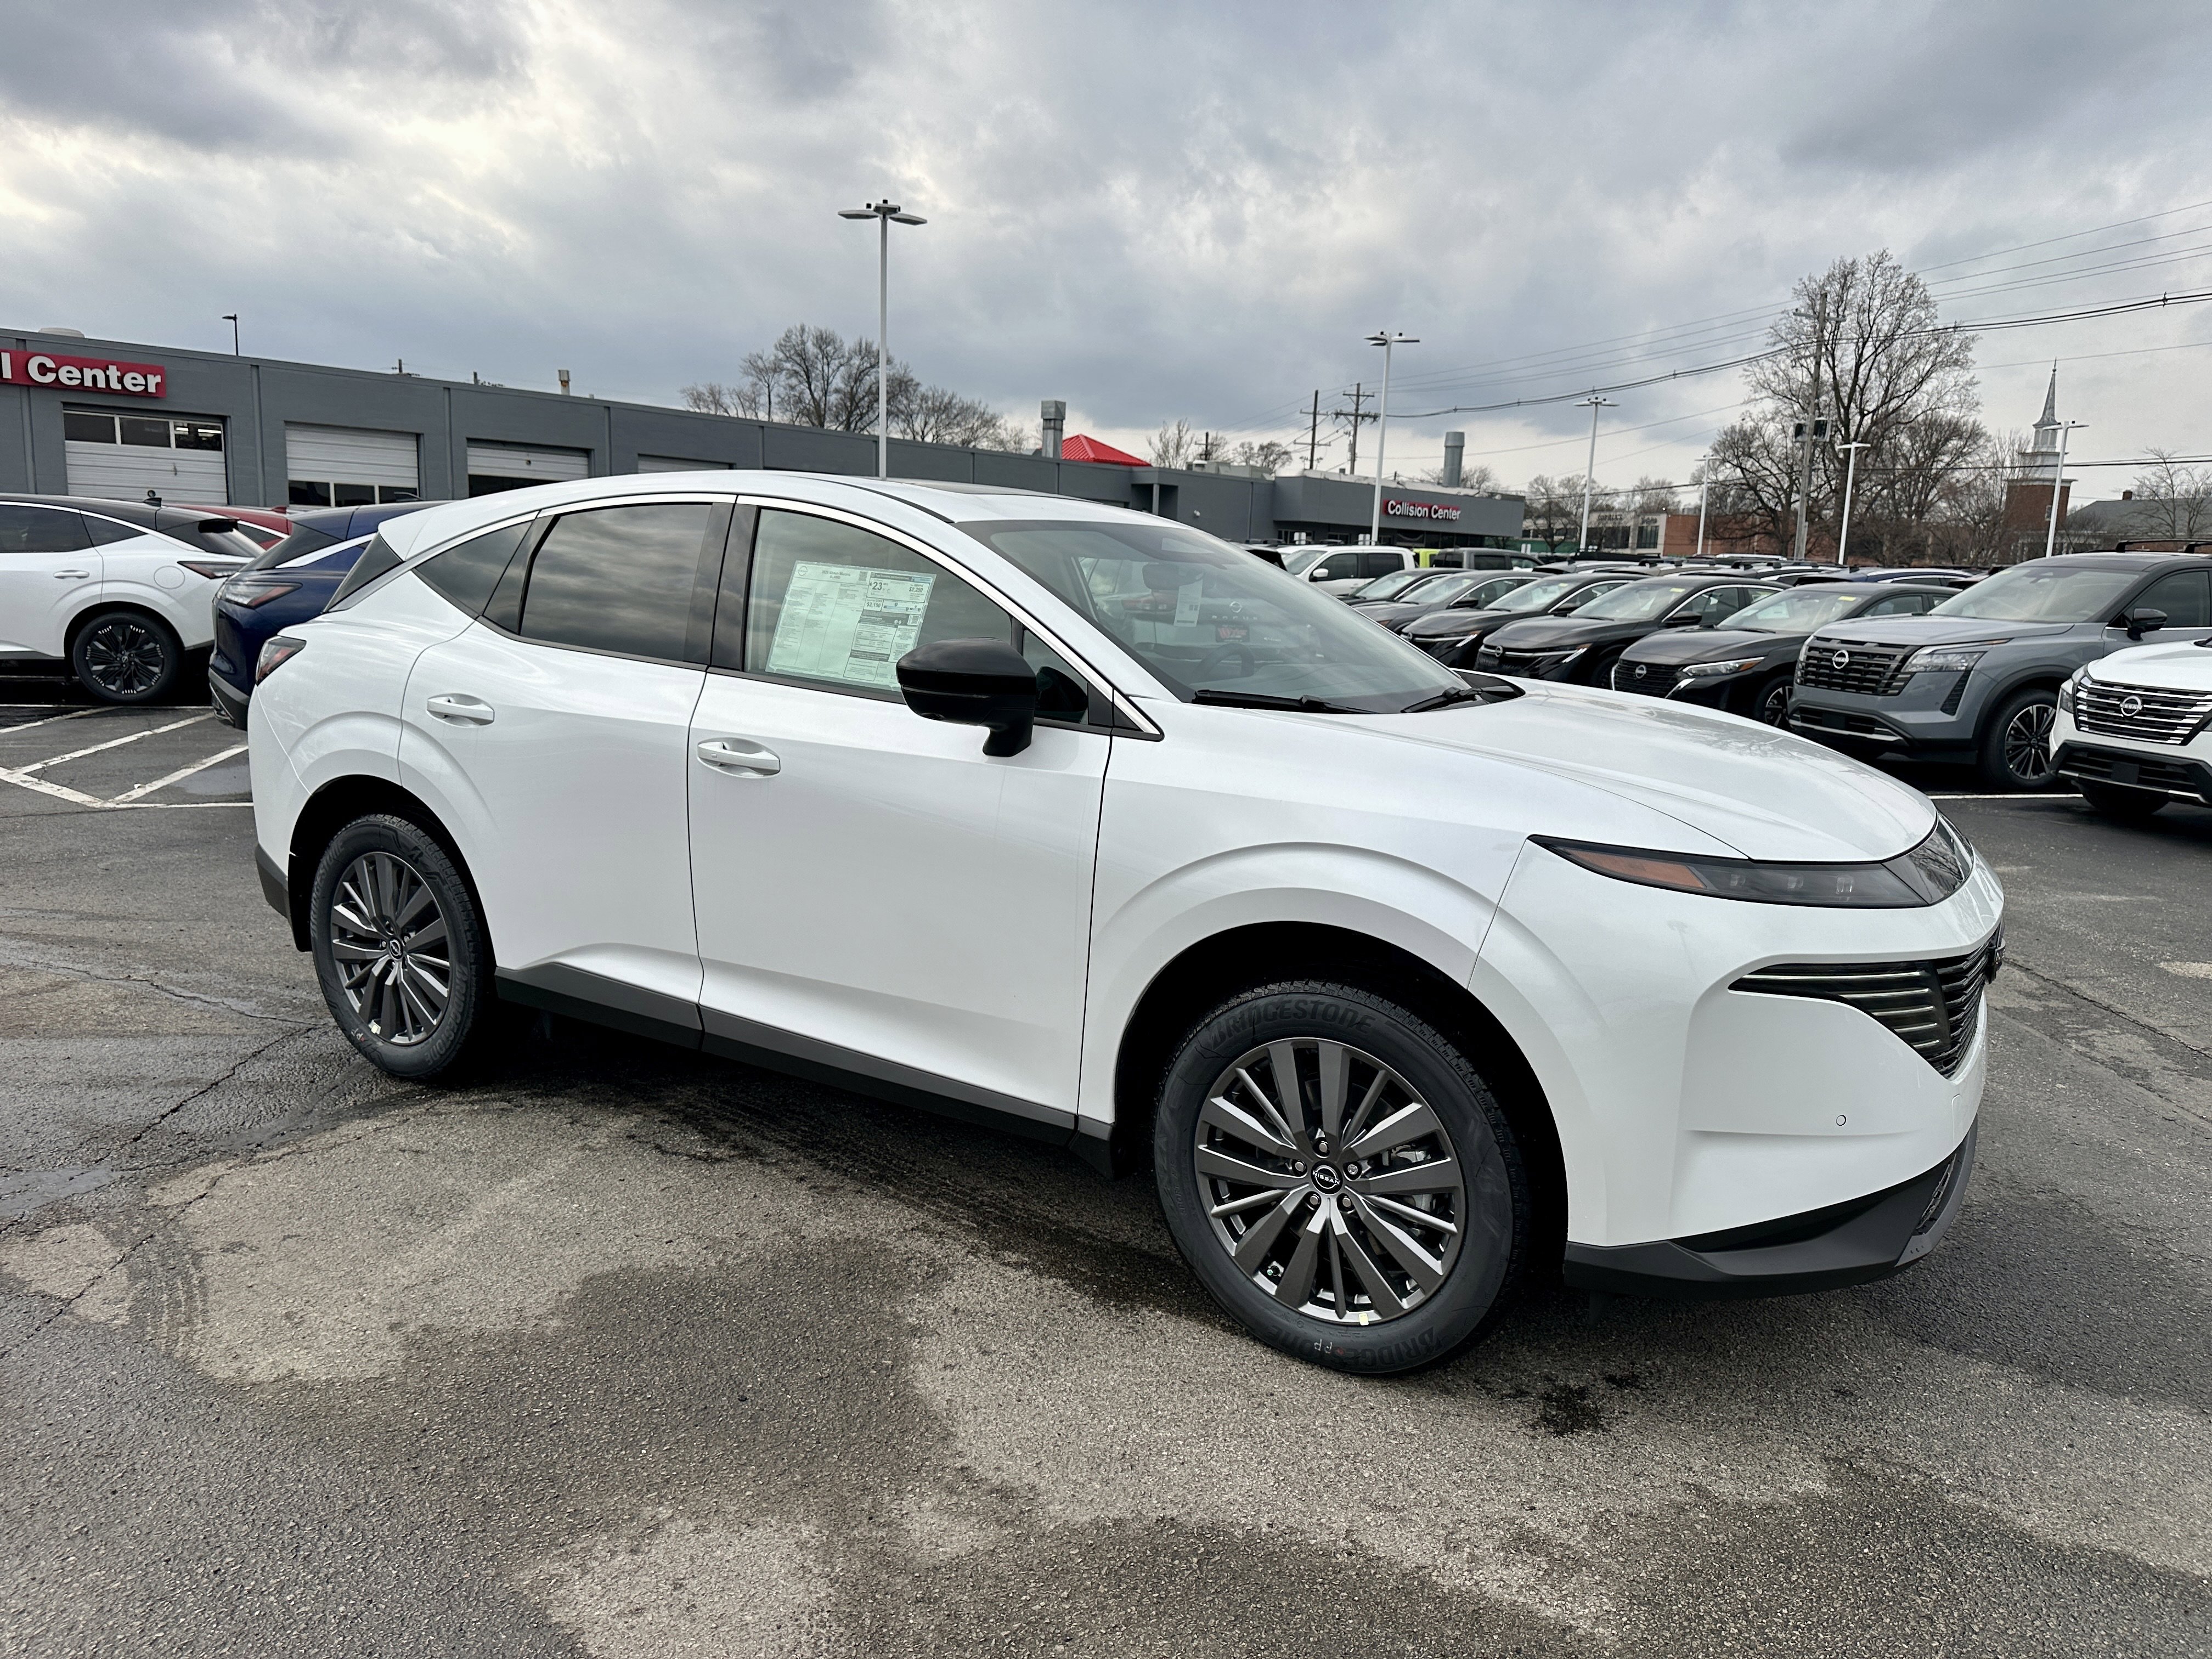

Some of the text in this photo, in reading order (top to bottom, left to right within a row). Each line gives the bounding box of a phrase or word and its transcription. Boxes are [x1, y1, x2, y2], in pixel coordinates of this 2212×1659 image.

[27, 356, 161, 393] Center
[1387, 500, 1462, 520] Collision Center
[872, 582, 883, 591] 23
[1209, 998, 1376, 1049] BRIDGESTONE
[1312, 1170, 1340, 1185] NISSAN
